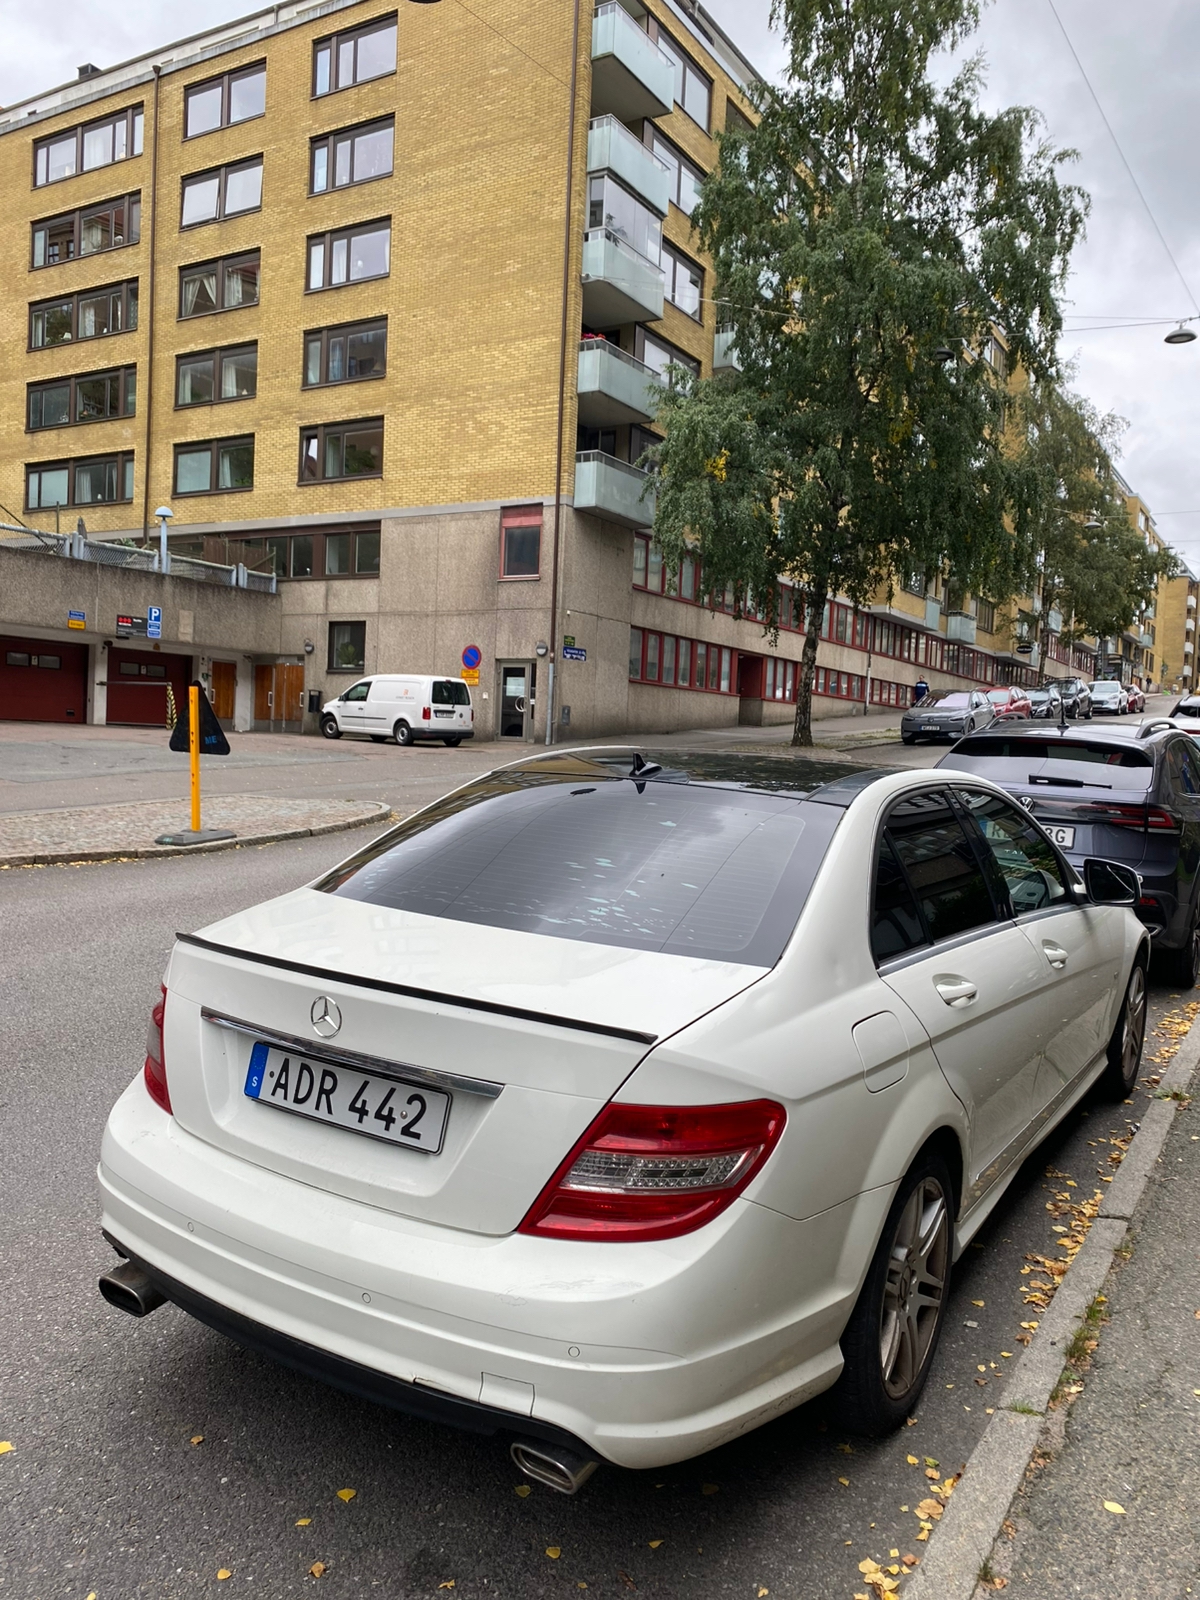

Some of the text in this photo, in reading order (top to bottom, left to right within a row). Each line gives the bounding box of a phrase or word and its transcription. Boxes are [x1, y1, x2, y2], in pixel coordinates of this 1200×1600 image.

[151, 608, 159, 621] P
[251, 1057, 427, 1140] S ADR 442
